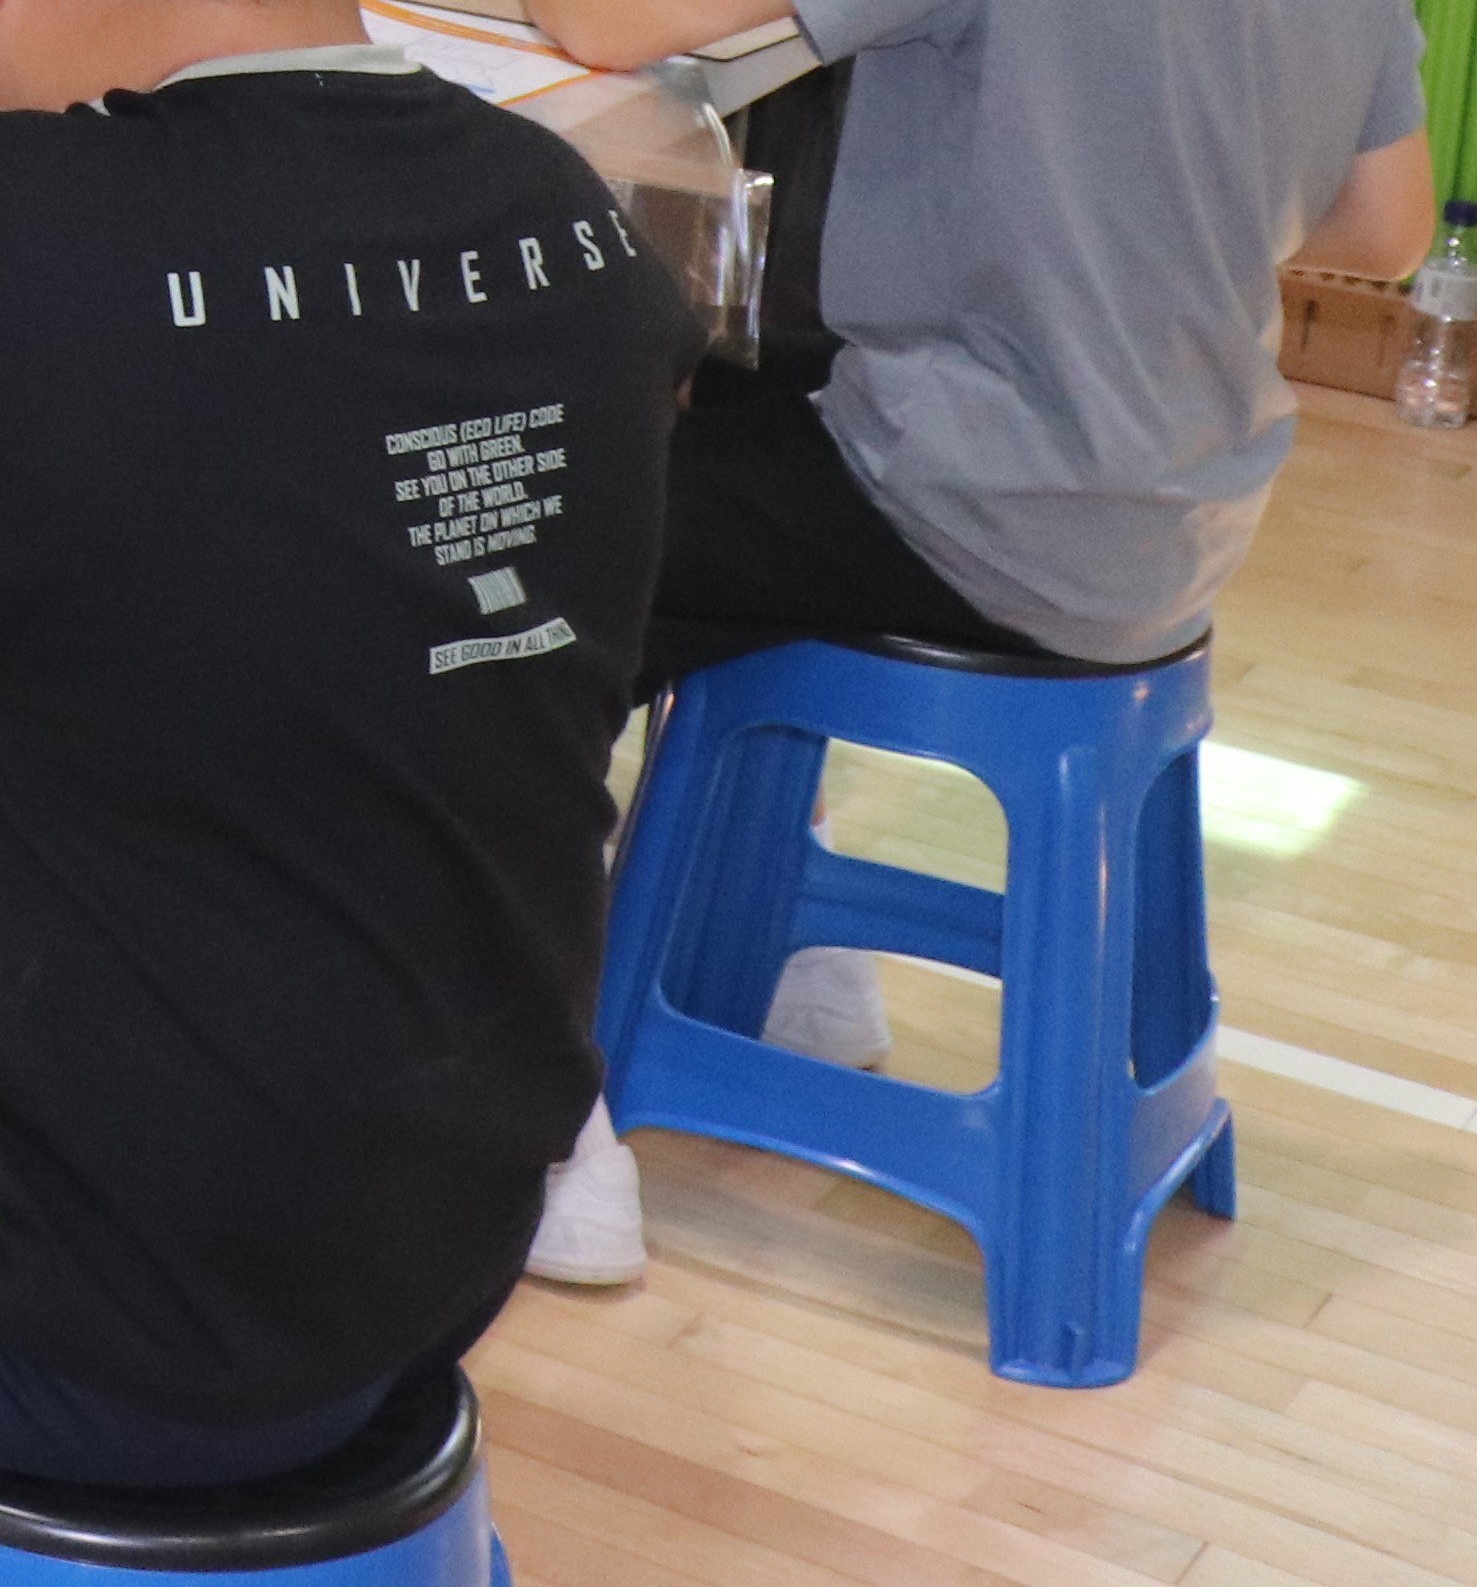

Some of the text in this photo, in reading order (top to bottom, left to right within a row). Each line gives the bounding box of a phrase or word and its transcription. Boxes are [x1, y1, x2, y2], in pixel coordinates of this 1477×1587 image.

[167, 210, 636, 327] UNIVERSE
[385, 403, 564, 455] CONSCIOUS (ECO LIFE) CODE
[394, 447, 567, 502] SEE YOU ON THE OTHER SIDE
[426, 449, 446, 472] GO
[446, 442, 479, 467] WITH
[407, 495, 563, 548] THE PLANET ON WHICH WE
[438, 496, 457, 517] OF
[457, 491, 481, 512] THE
[434, 539, 472, 566] STAND
[472, 536, 486, 557] IS
[435, 647, 457, 669] SEE
[461, 641, 502, 662] GOOD
[505, 639, 522, 656] IN
[524, 632, 546, 653] ALL
